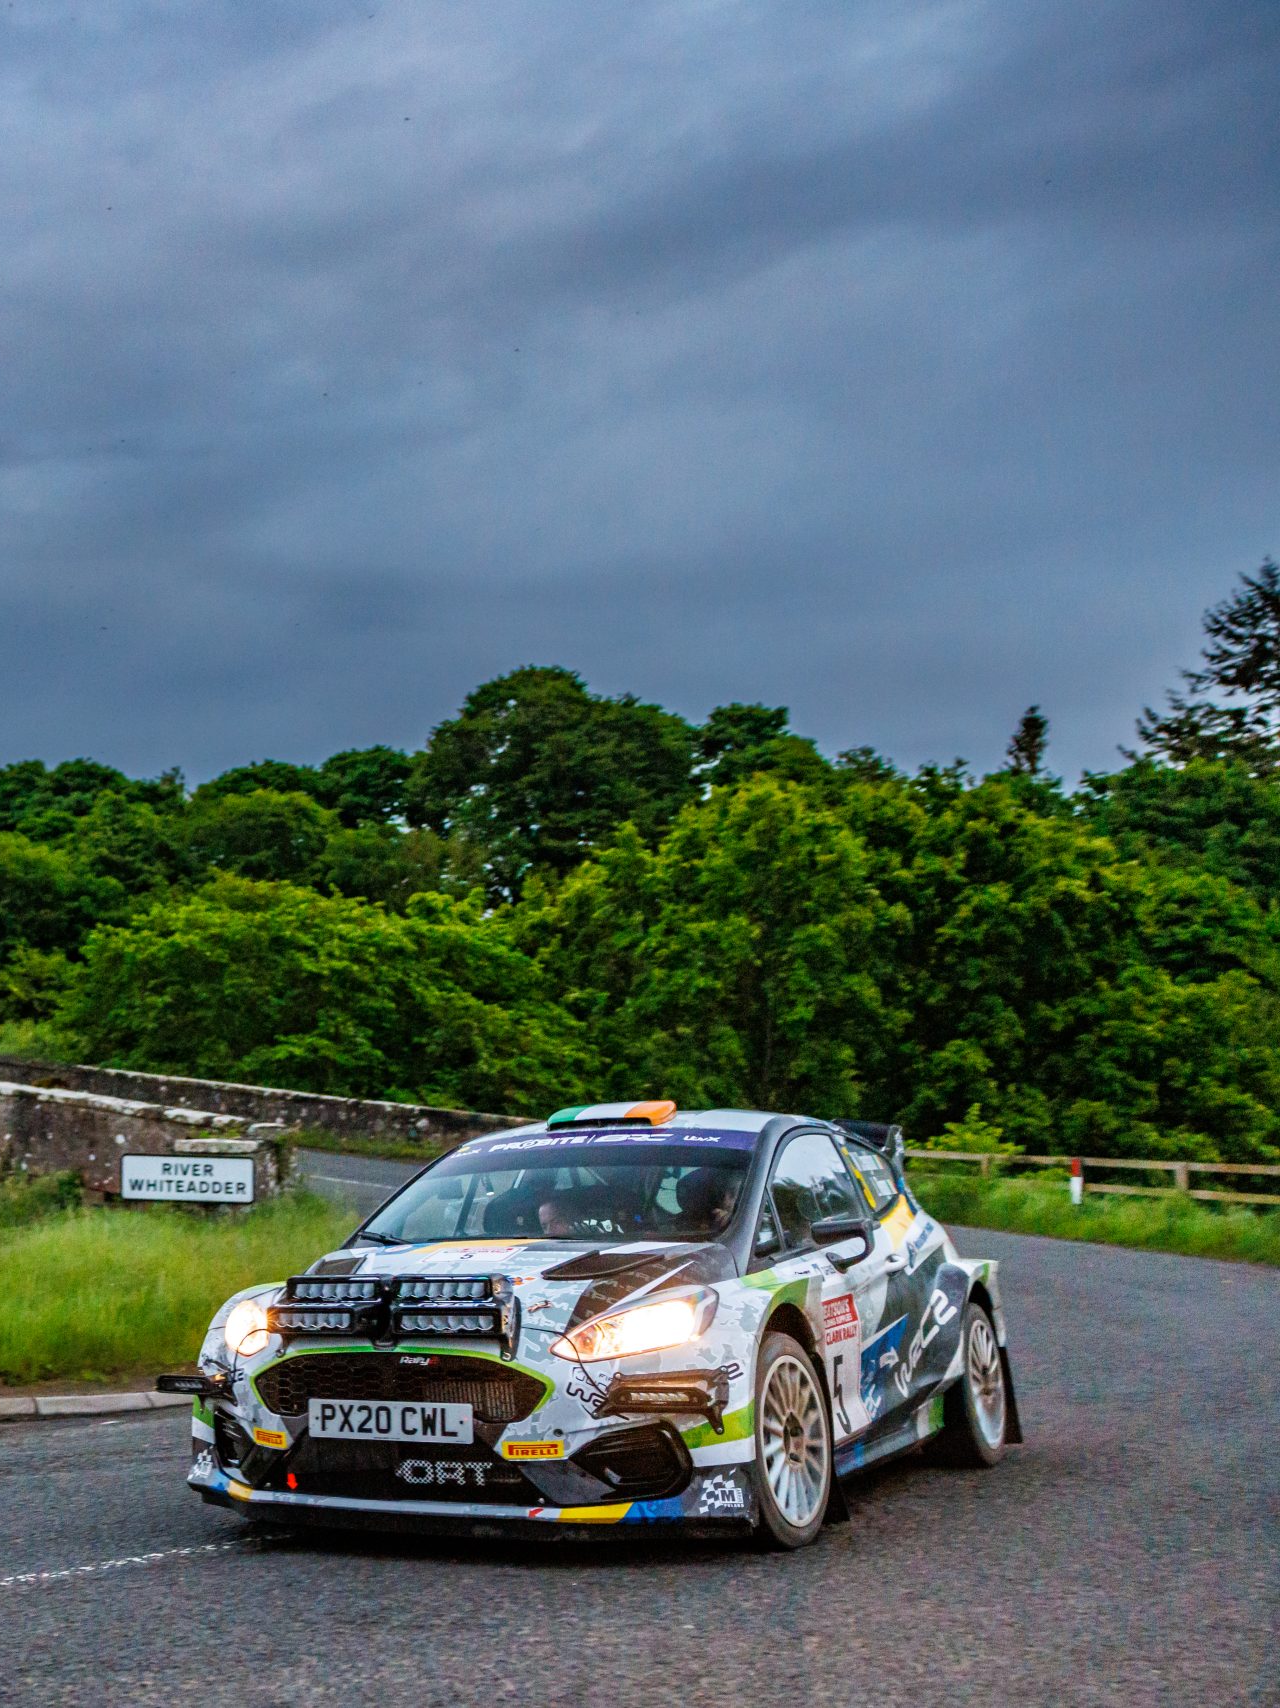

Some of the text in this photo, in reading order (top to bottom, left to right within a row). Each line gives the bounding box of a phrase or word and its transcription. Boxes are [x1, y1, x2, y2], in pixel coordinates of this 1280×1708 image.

[162, 1162, 214, 1177] RIVER
[129, 1179, 247, 1195] WHITEADDER
[826, 1323, 858, 1346] CLARK RALLY
[832, 1354, 852, 1435] 5
[320, 1403, 458, 1438] PX20 CWL
[256, 1430, 283, 1445] PIRELLI
[508, 1443, 559, 1456] PIRELLI
